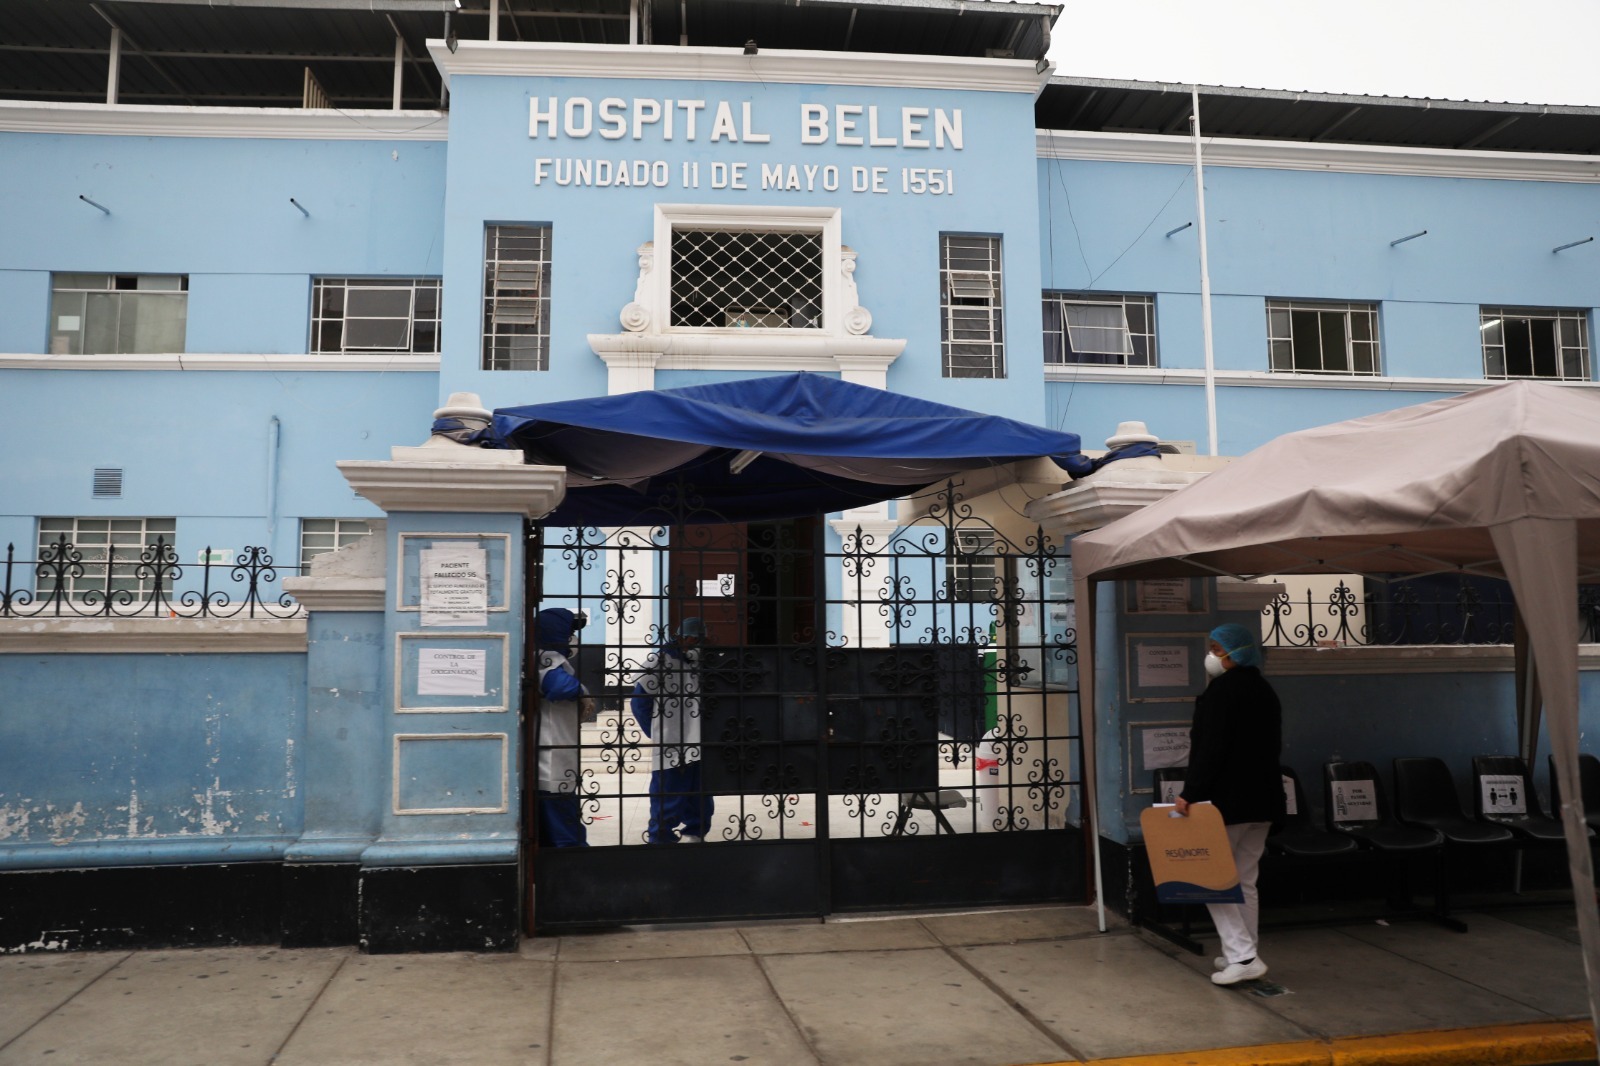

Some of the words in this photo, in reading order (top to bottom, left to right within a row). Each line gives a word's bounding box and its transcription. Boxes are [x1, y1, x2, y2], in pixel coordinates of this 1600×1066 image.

[528, 96, 771, 144] HOSPITAL
[800, 103, 964, 150] BELEN
[534, 158, 669, 188] FUNDADO
[711, 162, 748, 191] DE
[761, 163, 840, 192] MAYO
[852, 167, 889, 194] DE
[902, 168, 954, 196] 1551
